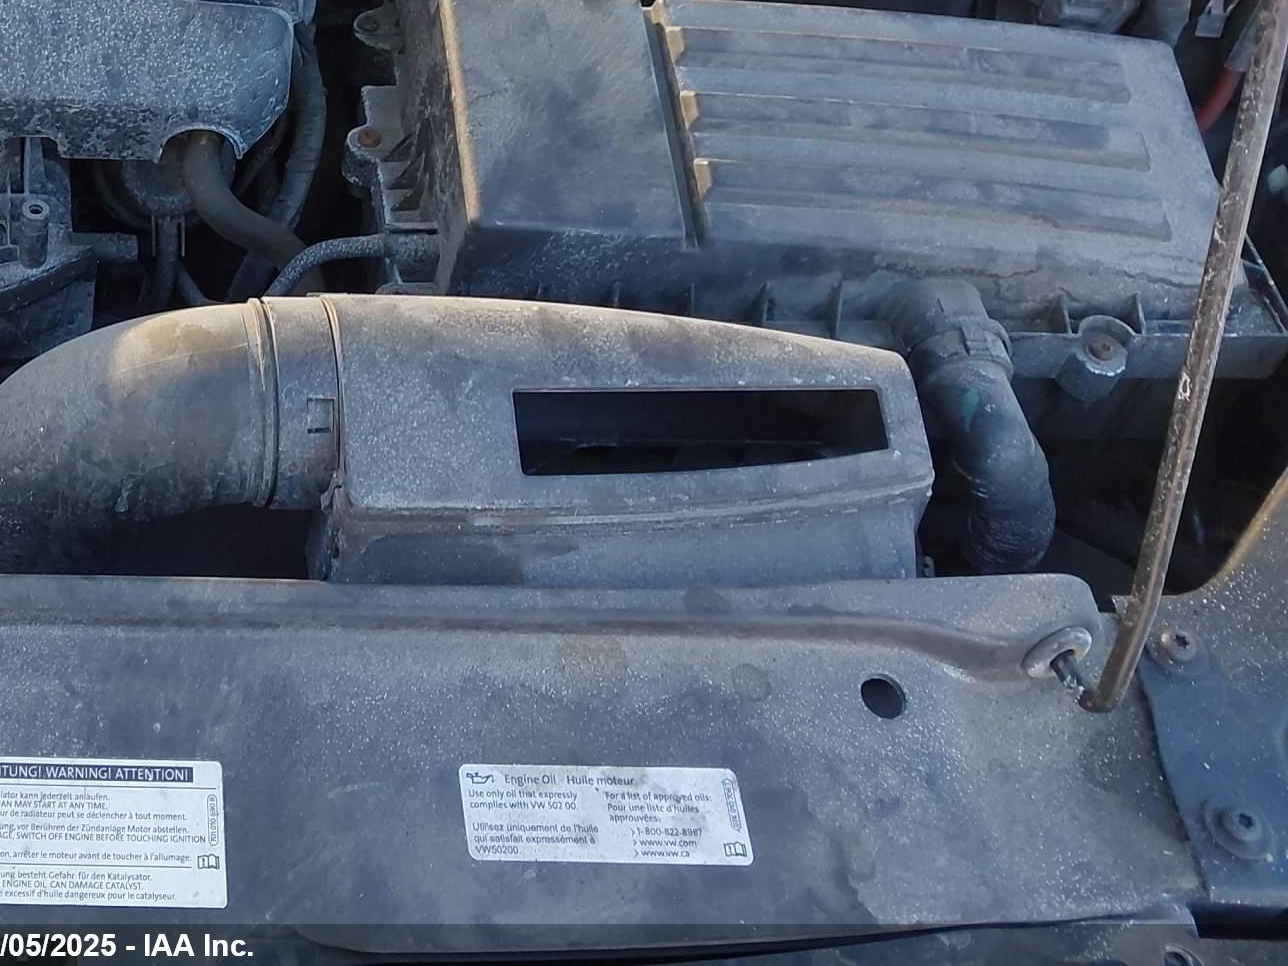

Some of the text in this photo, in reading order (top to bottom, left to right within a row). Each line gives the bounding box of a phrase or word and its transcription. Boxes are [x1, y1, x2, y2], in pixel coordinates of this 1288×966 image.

[46, 766, 112, 779] WARNING!
[115, 768, 188, 781] ATTENTION!
[505, 774, 556, 786] Engine Oil
[566, 775, 634, 786] Huile moteur
[20, 791, 38, 799] kann
[40, 792, 72, 801] jederzeit
[486, 790, 504, 800] only
[519, 790, 537, 798] that
[539, 792, 577, 801] expressly
[605, 792, 619, 800] For
[628, 792, 640, 800] list
[642, 792, 651, 800] of
[654, 794, 692, 803] approved
[15, 800, 32, 808] MAY
[470, 801, 507, 810] complies
[548, 802, 563, 810] 502
[608, 804, 626, 812] Pour
[666, 805, 699, 813] d'huiles
[21, 810, 55, 818] radiateur
[58, 811, 74, 819] peut
[86, 811, 126, 819] déclencher
[129, 811, 132, 819] à
[135, 812, 151, 820] tout
[31, 823, 65, 832] Berühren
[67, 824, 79, 832] der
[81, 824, 126, 834] Zündanlage
[128, 825, 151, 833] Motor
[473, 823, 598, 833] Utilisez uniquement de l'huile
[17, 832, 47, 840] SWITCH
[65, 833, 93, 841] ENGINE
[96, 834, 124, 842] BEFORE
[170, 835, 206, 843] IGNITION
[474, 835, 487, 843] qui
[490, 835, 523, 843] satisfait
[13, 851, 39, 859] arrêter
[41, 851, 47, 859] le
[78, 852, 100, 860] avant
[113, 853, 142, 861] toucher
[144, 853, 148, 861] à
[641, 850, 690, 858] www.vw.ca
[18, 871, 46, 879] besteht
[48, 871, 75, 879] Gefahr
[78, 872, 89, 880] für
[5, 889, 35, 898] excessif
[37, 889, 63, 898] d'huile
[64, 891, 106, 900] dangereux
[108, 892, 125, 903] pour
